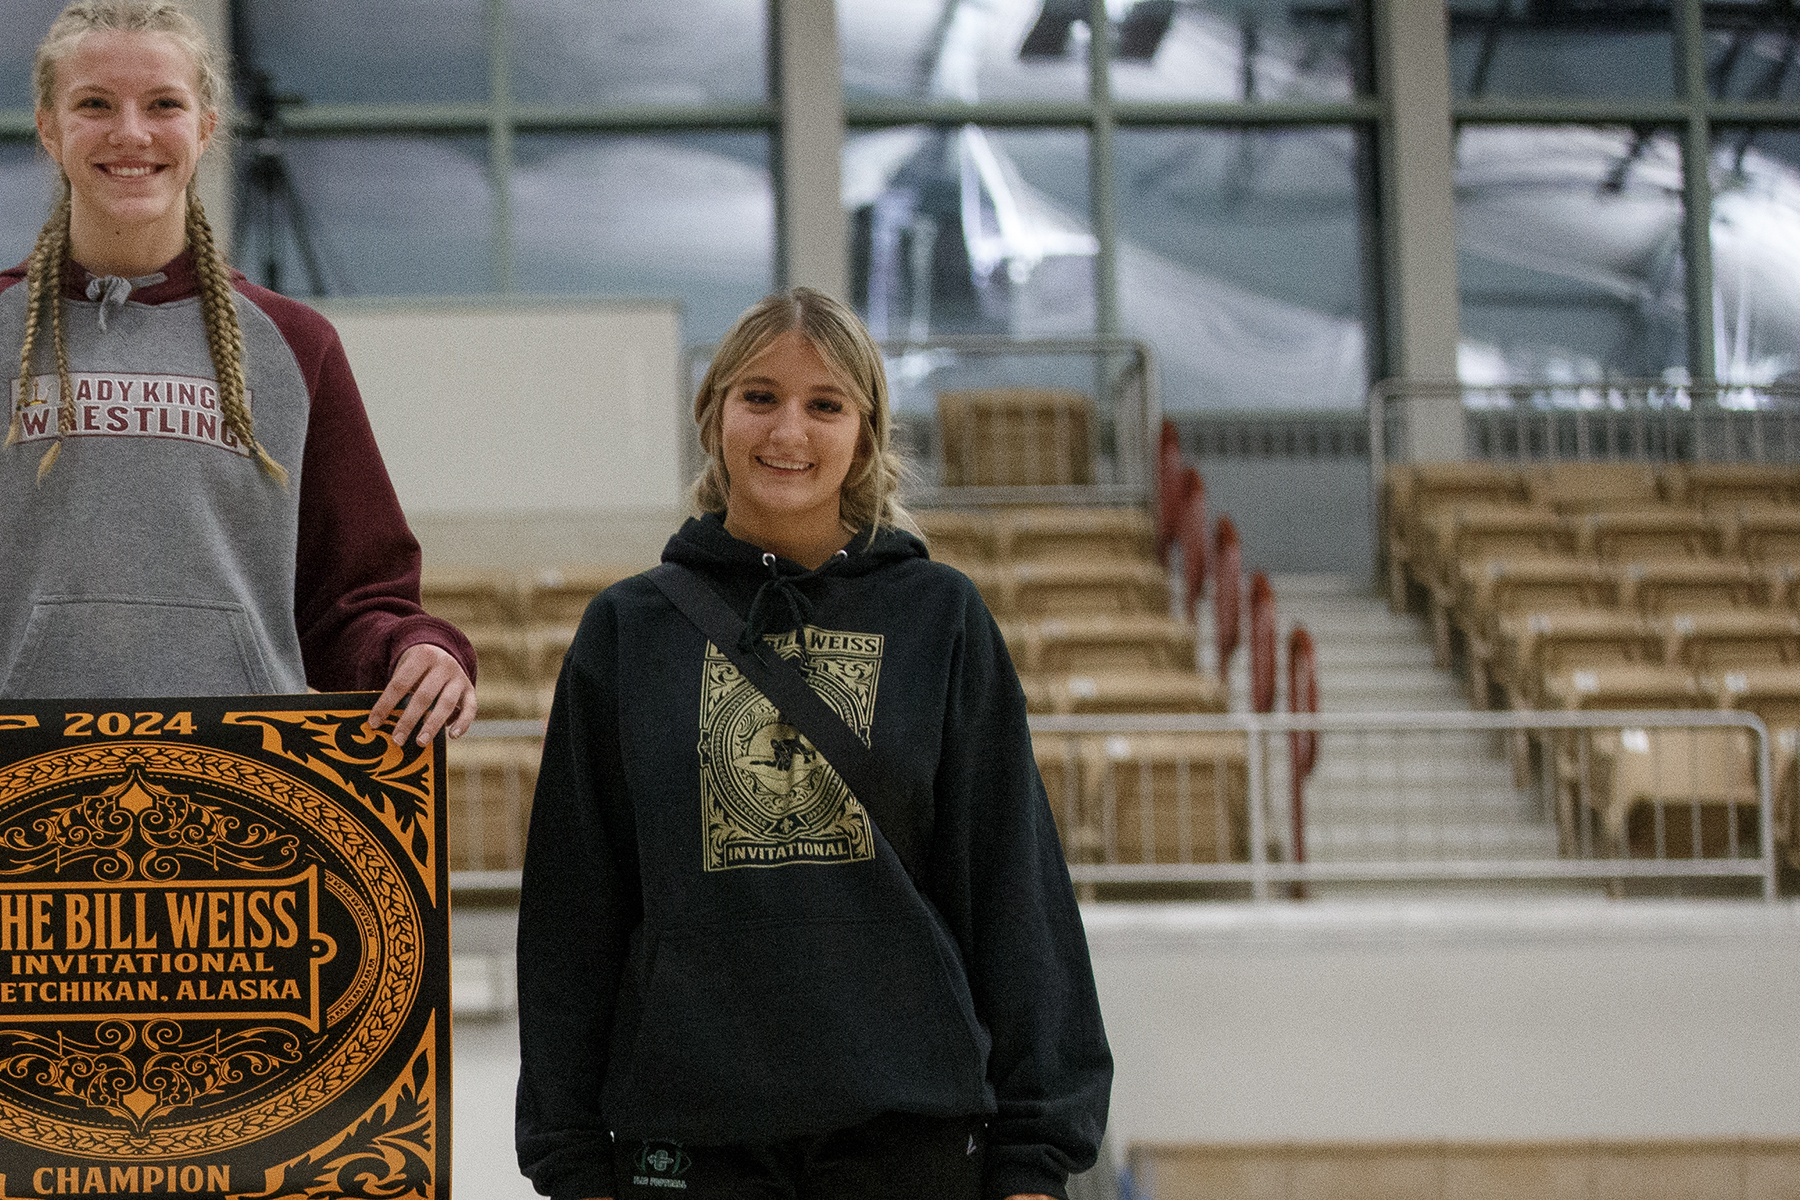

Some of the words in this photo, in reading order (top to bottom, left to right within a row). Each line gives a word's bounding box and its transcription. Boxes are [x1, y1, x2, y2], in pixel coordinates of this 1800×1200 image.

[142, 381, 225, 411] KING
[810, 631, 878, 652] WEISS
[63, 711, 198, 737] 2024
[728, 841, 848, 861] INVITATIONAL
[66, 892, 158, 950] BILL
[166, 890, 298, 949] WEISS
[10, 951, 274, 976] INVITATIONAL
[175, 978, 302, 1002] ALASKA
[32, 1164, 231, 1196] CHAMPION
